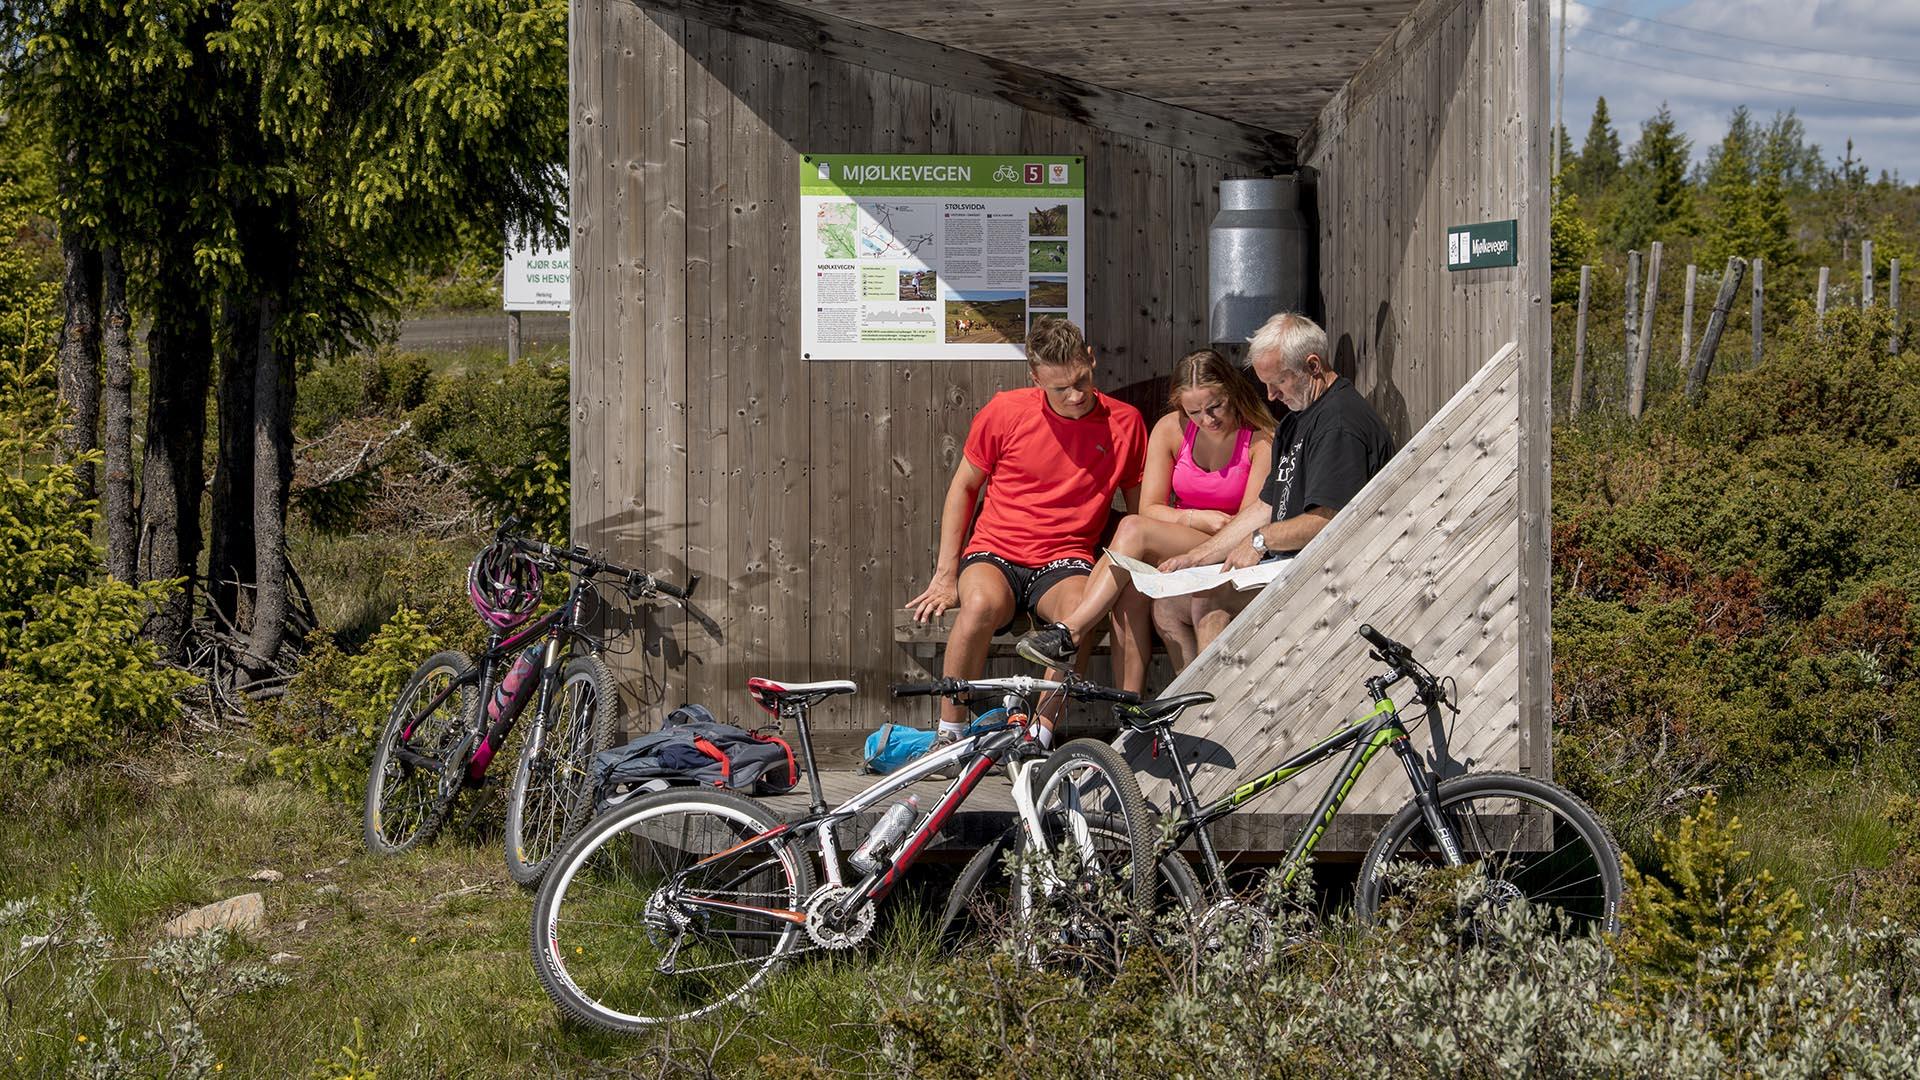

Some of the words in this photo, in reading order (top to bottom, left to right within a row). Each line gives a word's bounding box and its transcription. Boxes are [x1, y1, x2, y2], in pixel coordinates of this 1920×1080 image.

[843, 165, 971, 184] MJØLKEVEGEN
[1029, 167, 1037, 181] 5
[527, 260, 550, 269] KJØR
[526, 274, 540, 283] VIS
[543, 947, 565, 985] KENDA
